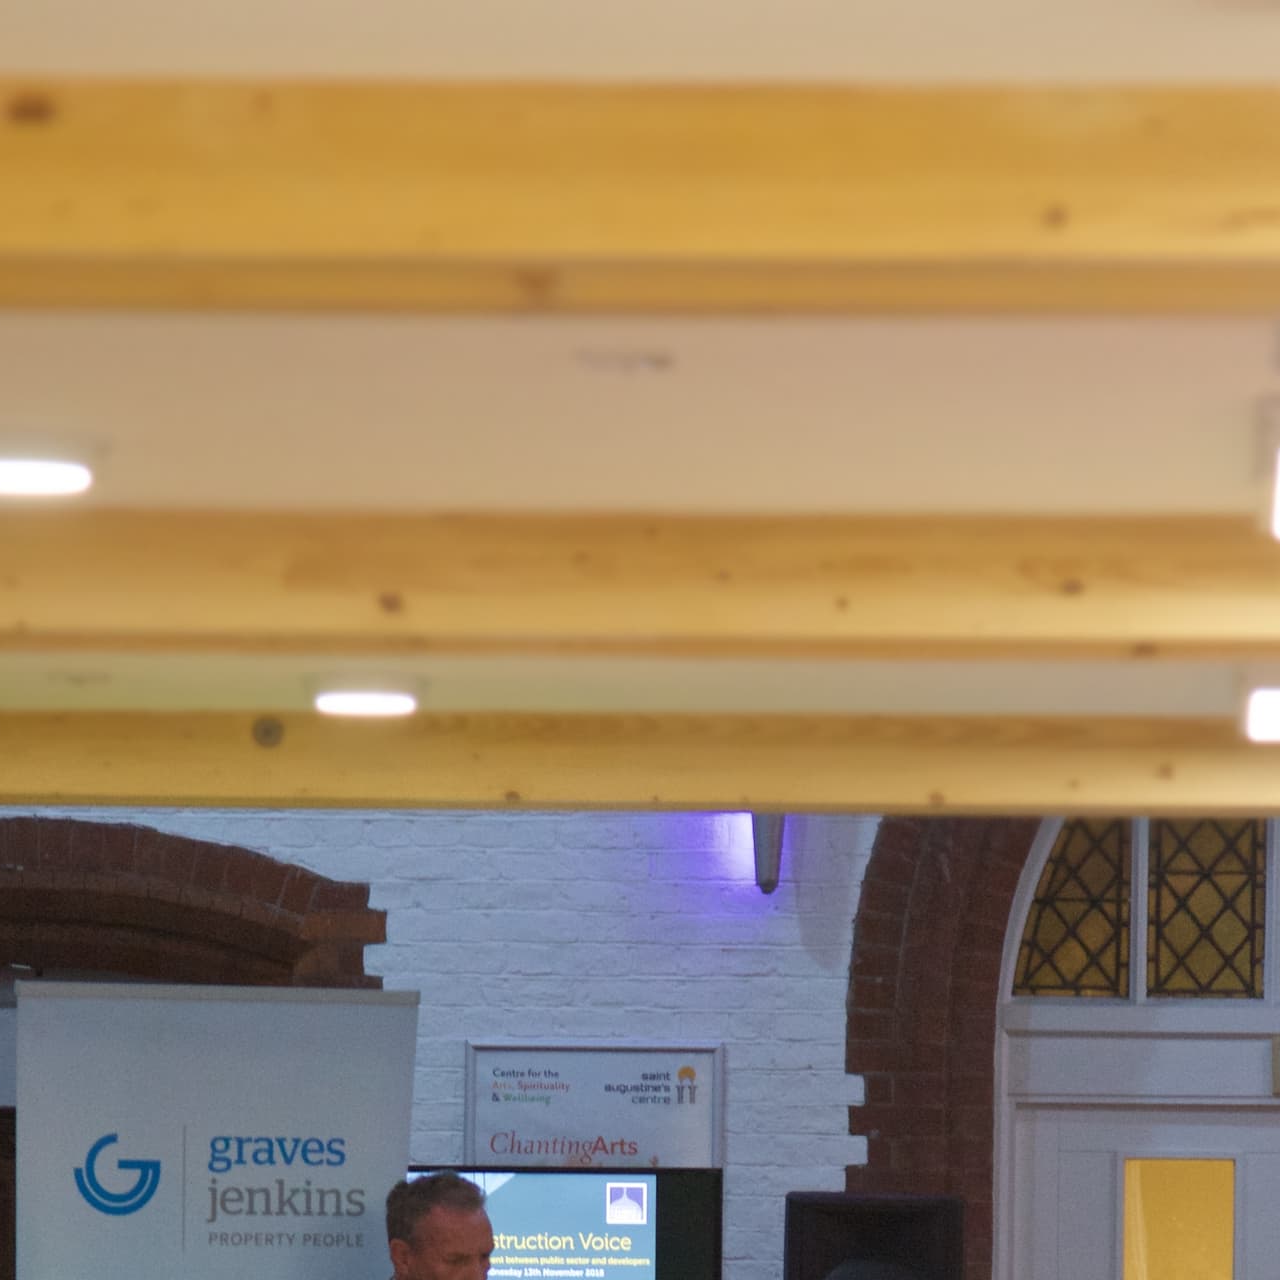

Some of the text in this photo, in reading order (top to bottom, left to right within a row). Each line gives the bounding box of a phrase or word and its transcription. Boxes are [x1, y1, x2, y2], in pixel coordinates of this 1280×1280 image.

[492, 1067, 560, 1078] Centre for the
[641, 1072, 671, 1081] saint
[517, 1080, 571, 1092] Spirituality
[631, 1095, 671, 1105] centre
[207, 1135, 347, 1174] graves
[206, 1178, 366, 1223] jenkins
[208, 1231, 365, 1248] PROPERTY PEOPLE
[493, 1231, 632, 1251] struction Voice
[505, 1255, 539, 1265] between
[540, 1255, 565, 1267] public
[591, 1256, 607, 1265] and
[607, 1256, 650, 1267] developers
[487, 1267, 522, 1278] dnesday
[543, 1267, 584, 1278] November
